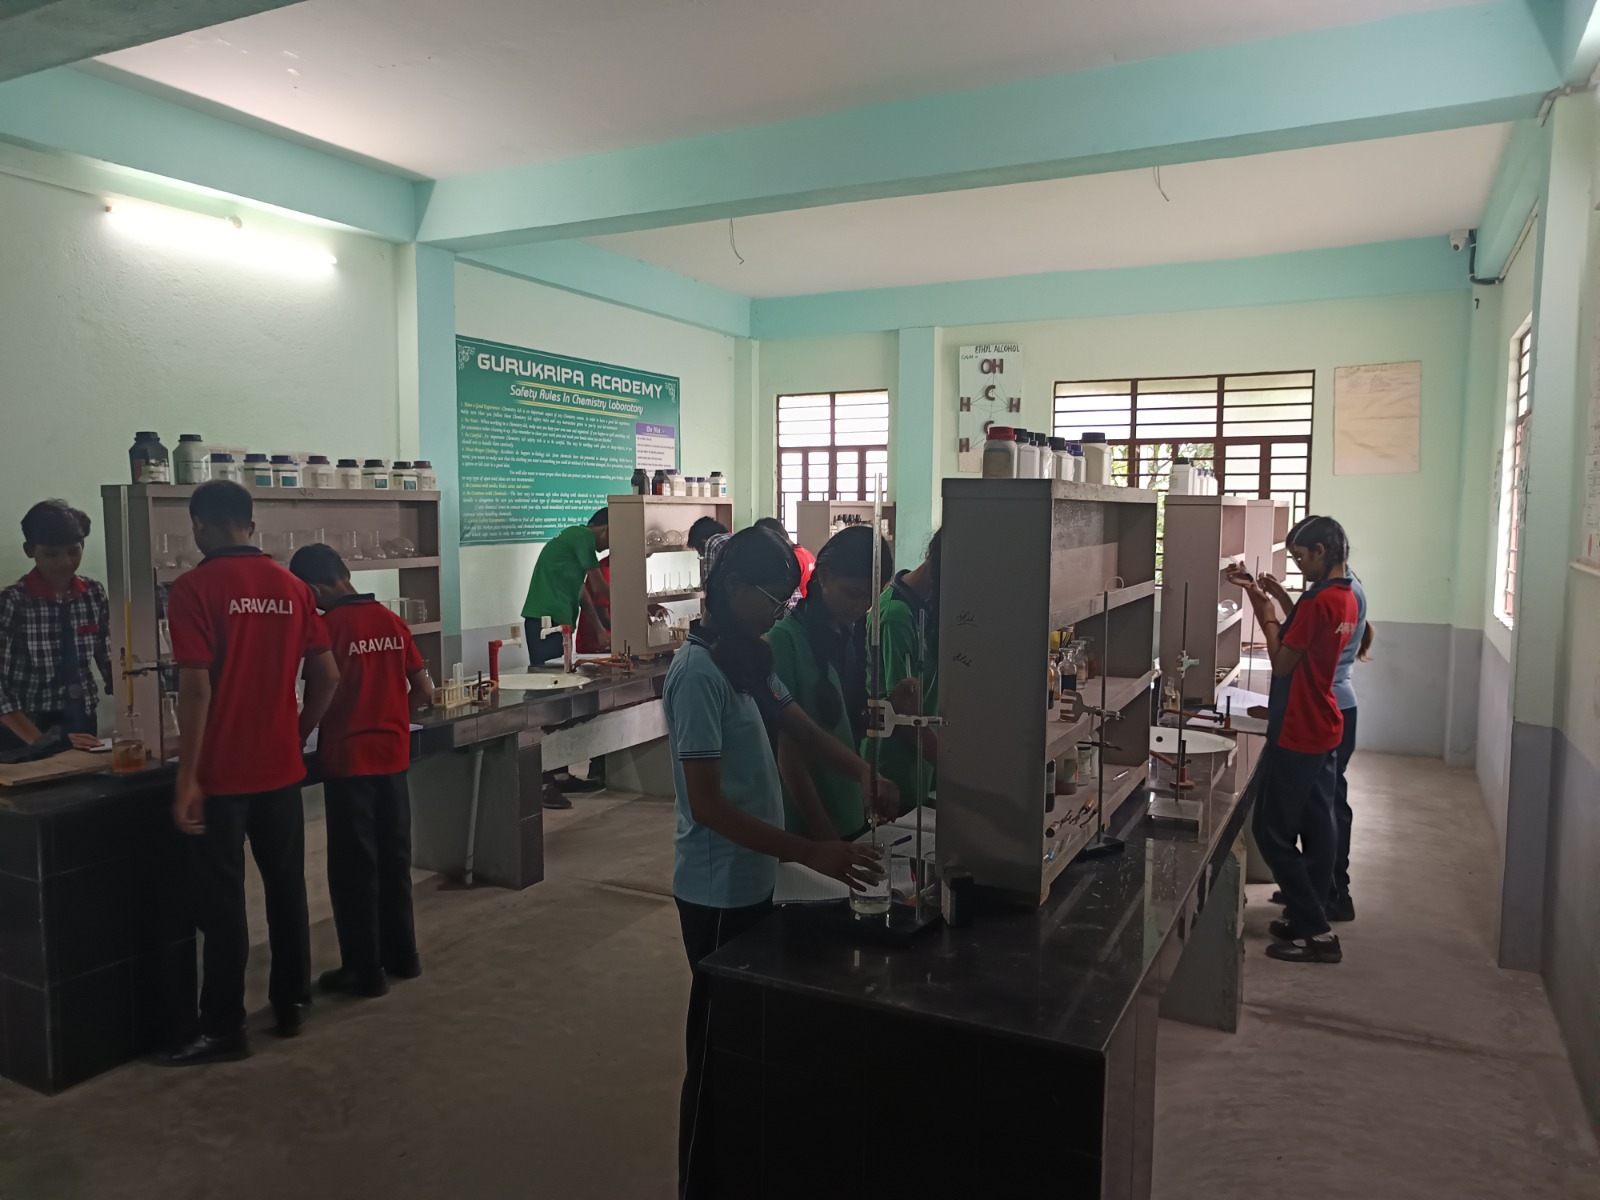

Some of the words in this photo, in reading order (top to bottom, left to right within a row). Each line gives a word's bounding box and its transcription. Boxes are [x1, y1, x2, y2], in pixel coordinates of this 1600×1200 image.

[981, 358, 1004, 374] OH
[478, 354, 584, 387] GURUKRIPA
[591, 373, 662, 399] ACADEMY
[510, 384, 537, 401] Safety
[539, 387, 561, 402] Rules
[563, 392, 570, 403] In
[572, 394, 606, 410] Chemistry
[608, 398, 643, 416] Laboratory
[960, 397, 971, 412] H
[1009, 398, 1020, 412] H
[959, 438, 969, 452] H
[229, 598, 293, 615] ARAVALI
[348, 637, 404, 656] ARAVALI
